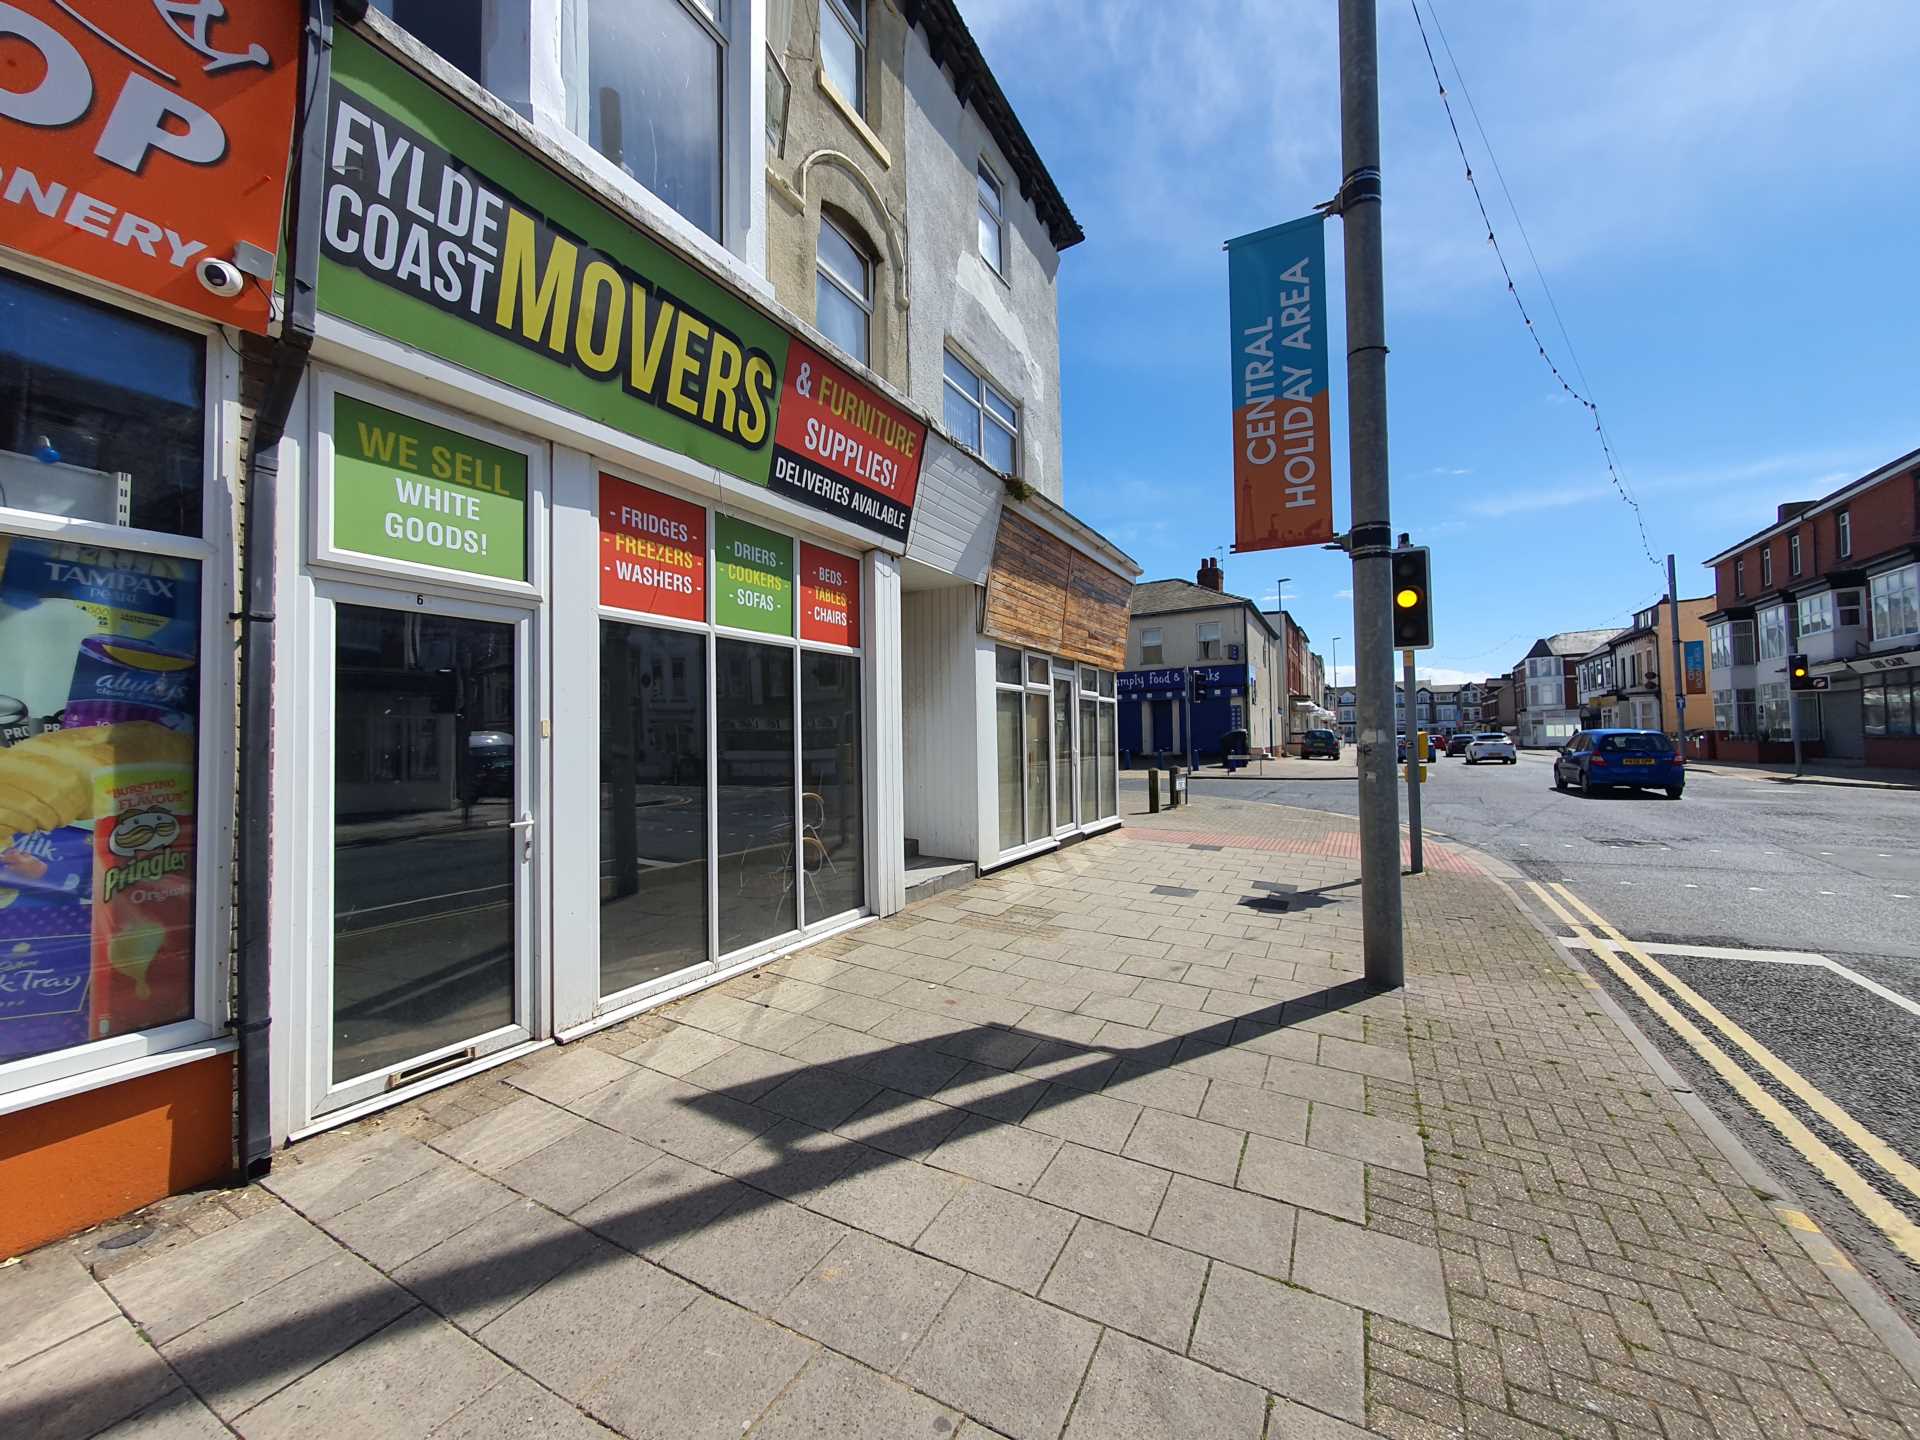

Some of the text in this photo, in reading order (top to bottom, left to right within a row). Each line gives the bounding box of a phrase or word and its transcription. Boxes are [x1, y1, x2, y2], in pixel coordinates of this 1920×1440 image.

[331, 100, 503, 257] FYLDE
[0, 165, 208, 267] NERY
[325, 183, 495, 314] COAST
[495, 207, 773, 445] MOVERS
[1244, 316, 1277, 465] CENTRAL
[1280, 256, 1316, 509] HOLIDAY AREA
[796, 362, 917, 458] & FURNITURE
[357, 420, 510, 496] WE SELL
[804, 417, 898, 490] SUPPLIES!
[395, 477, 481, 521] WHITE
[775, 456, 906, 530] DELIVERIES AVAILABLE
[385, 512, 487, 556] GOODS!
[621, 505, 688, 542] FRIDGES
[615, 532, 694, 569] FREEZERS
[734, 541, 777, 567] DRIERS
[44, 561, 174, 598] TAMPAX
[616, 559, 693, 594] WASHERS
[728, 564, 782, 591] COOKERS
[818, 566, 842, 586] BEDS
[416, 593, 424, 606] 6
[737, 589, 775, 612] SOFAS
[814, 586, 847, 607] TABLES
[814, 607, 847, 626] CHAIRS
[1149, 671, 1171, 684] Food
[104, 848, 188, 903] Pringles
[14, 968, 81, 997] Tray
